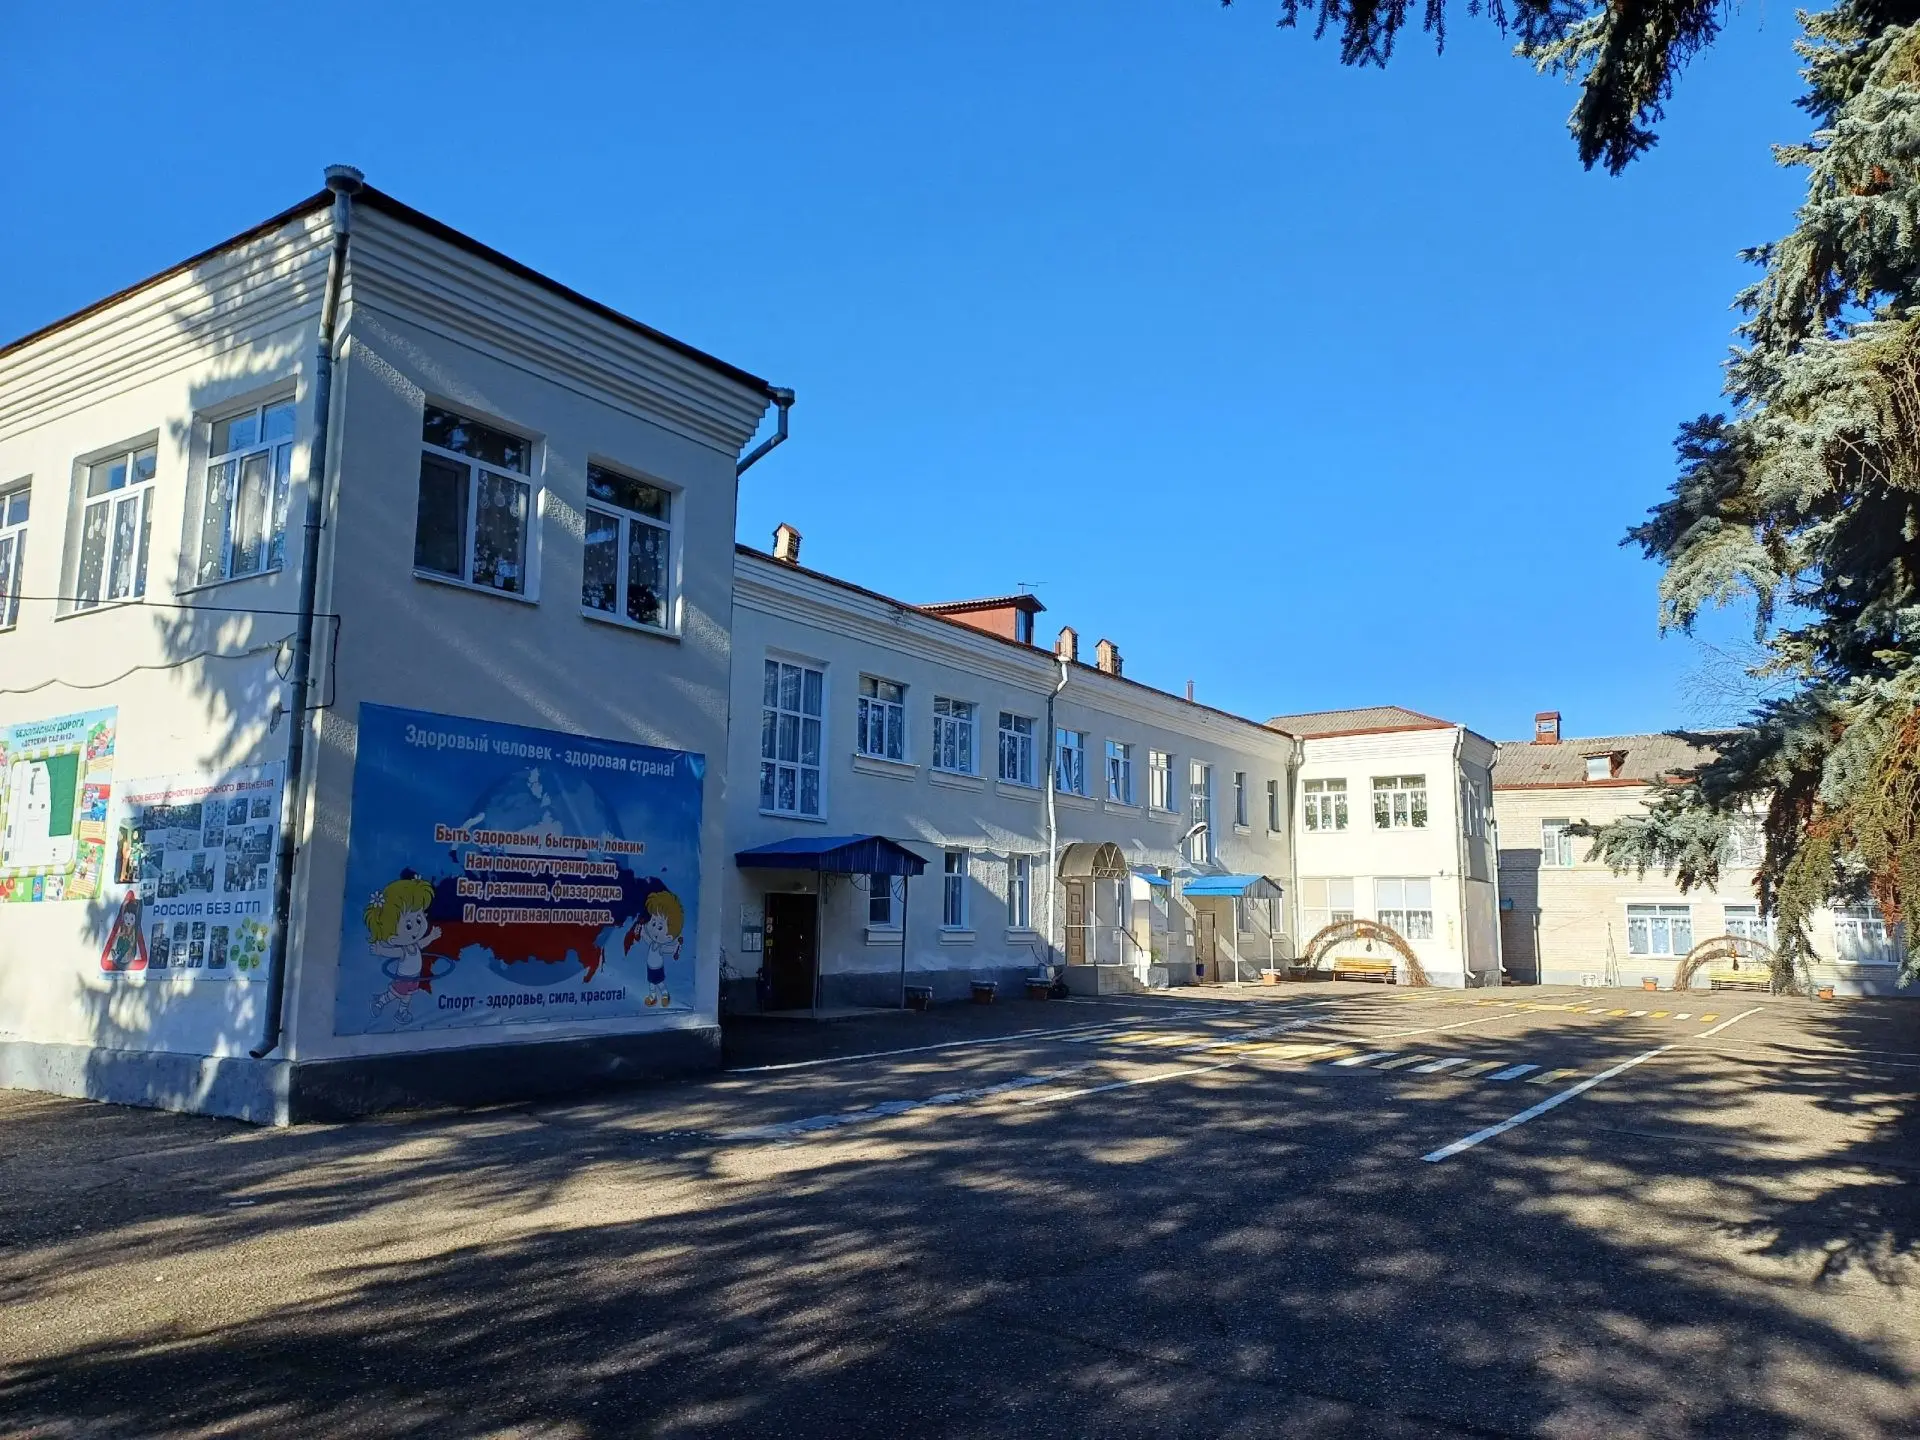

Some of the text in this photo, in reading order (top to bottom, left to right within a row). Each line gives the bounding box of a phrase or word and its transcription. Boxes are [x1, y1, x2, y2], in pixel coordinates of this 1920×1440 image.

[16, 719, 84, 738] БЕЗОПАСНАЯ ДОРОГА
[404, 724, 489, 753] Здоровый
[493, 739, 553, 761] человек
[564, 750, 627, 772] здоровая
[629, 758, 676, 778] страна!
[435, 825, 645, 854] Быть здоровым, быстрым, ловким
[466, 853, 619, 879] Нам помогут тренировки,
[458, 879, 622, 902] Бег, разминка, физзарядка
[152, 900, 261, 917] РОССИЯ БЕЗ ДТП
[464, 905, 614, 926] И спортивная площадка.
[438, 993, 476, 1012] Спорт
[486, 991, 546, 1010] здоровье,
[548, 990, 578, 1006] сила,
[580, 985, 626, 1006] красота!
